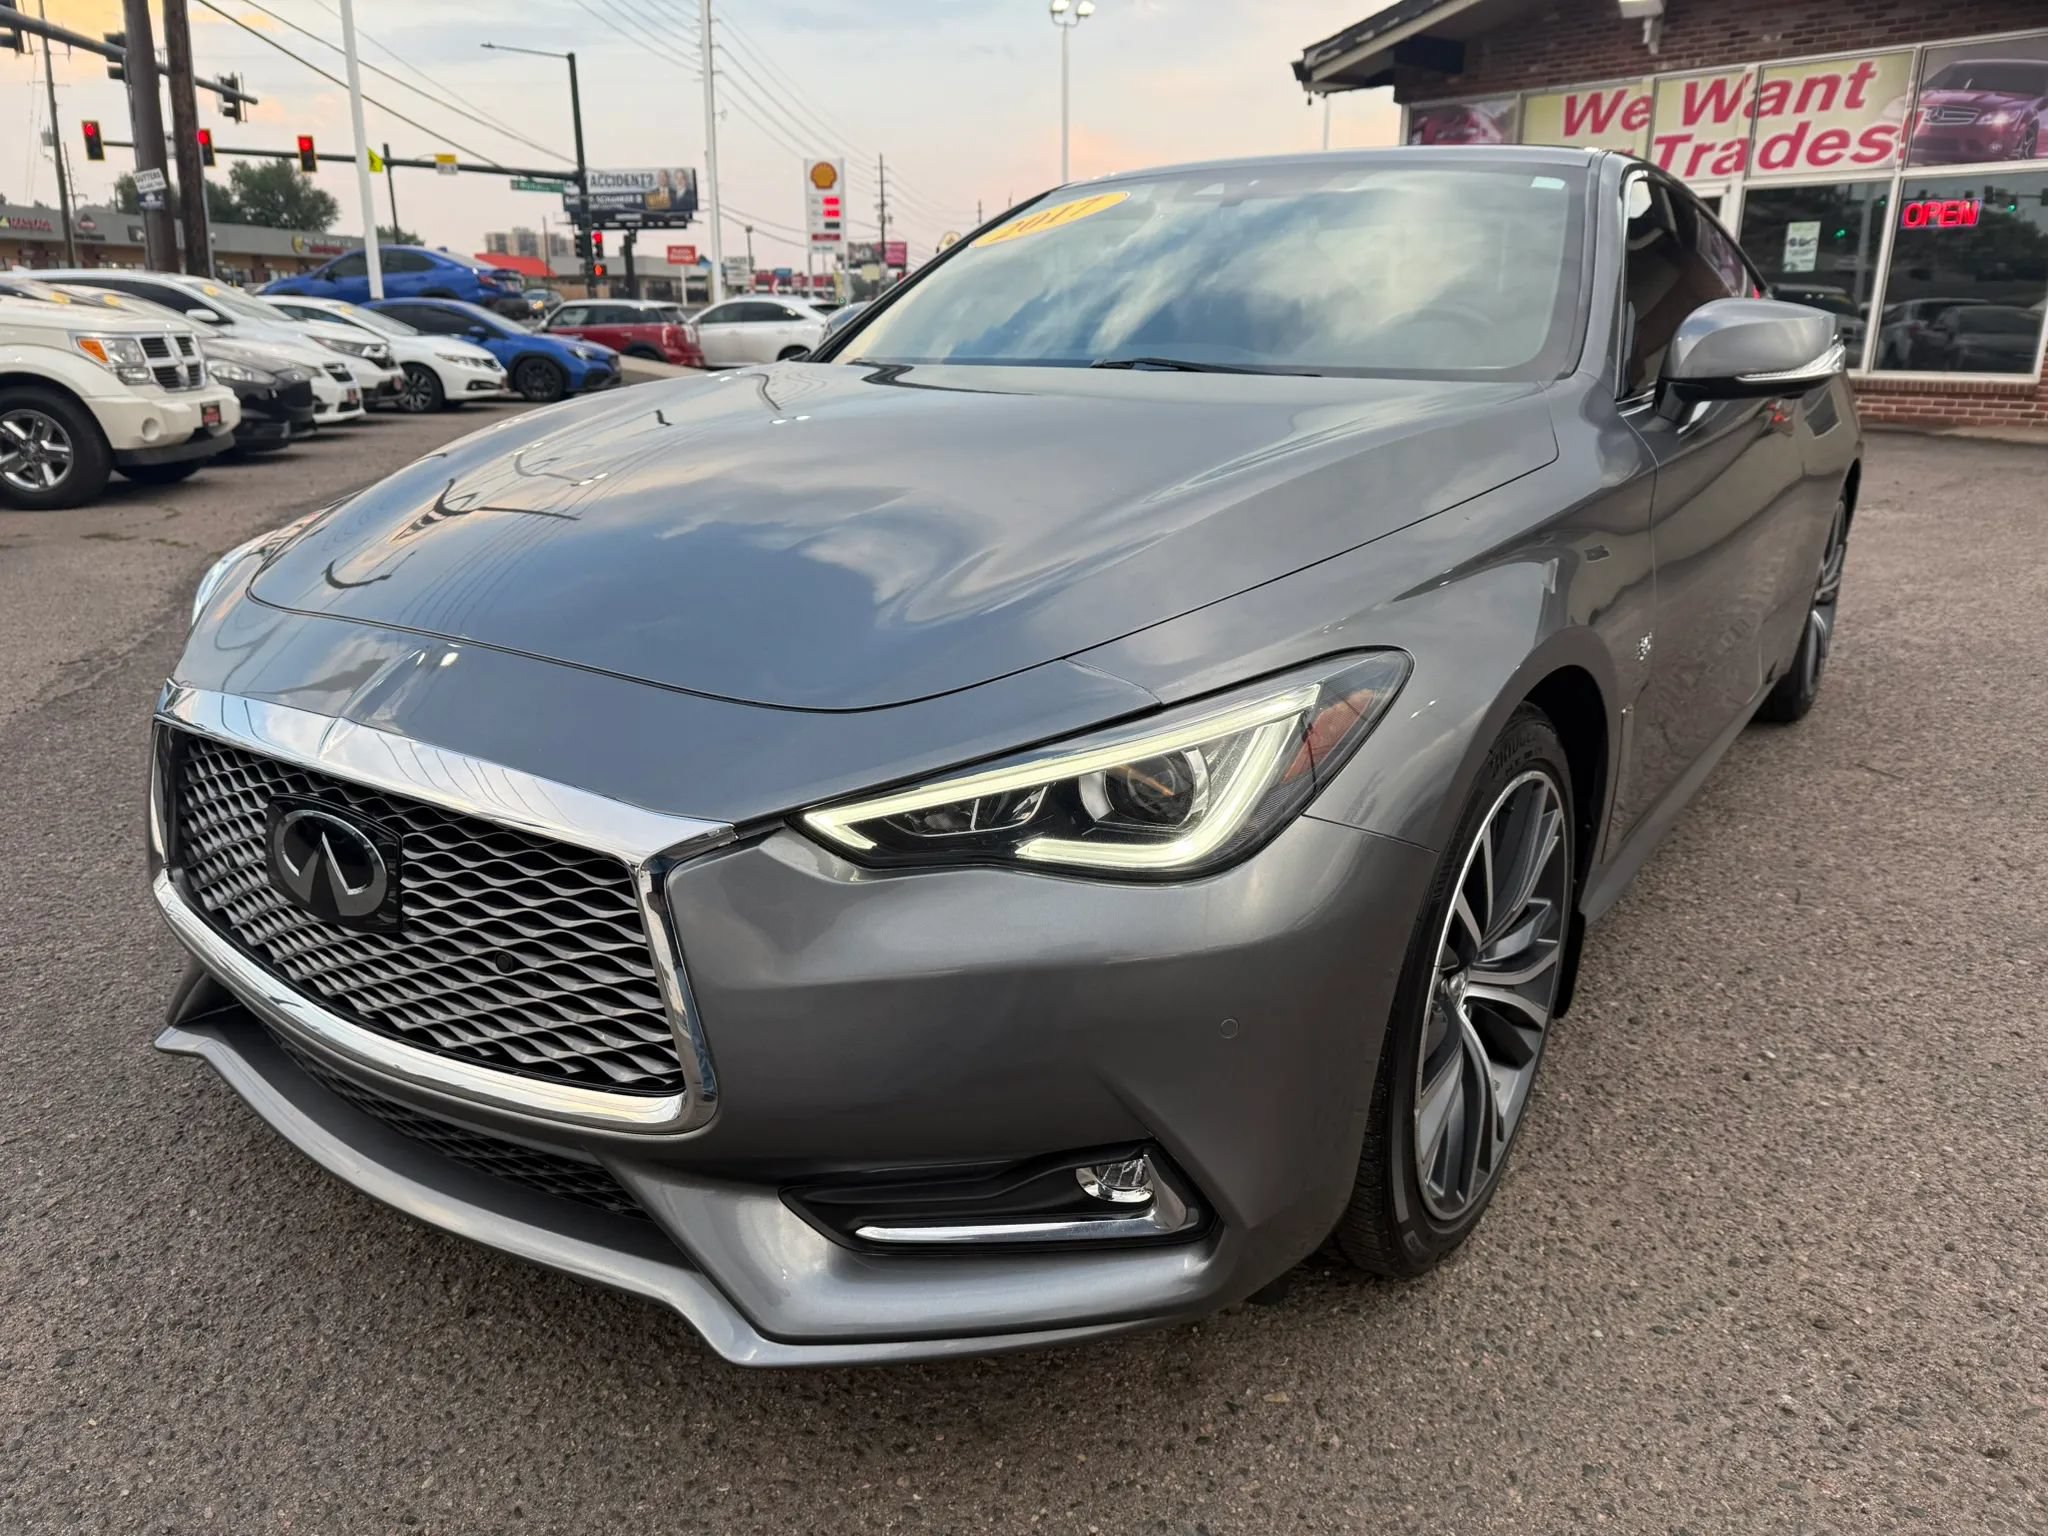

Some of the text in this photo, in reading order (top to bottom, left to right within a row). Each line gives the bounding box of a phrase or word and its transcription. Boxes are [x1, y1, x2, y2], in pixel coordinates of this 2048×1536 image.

[1563, 61, 1877, 137] We Want
[990, 195, 1105, 242] 2017
[1903, 199, 1980, 229] OPEN
